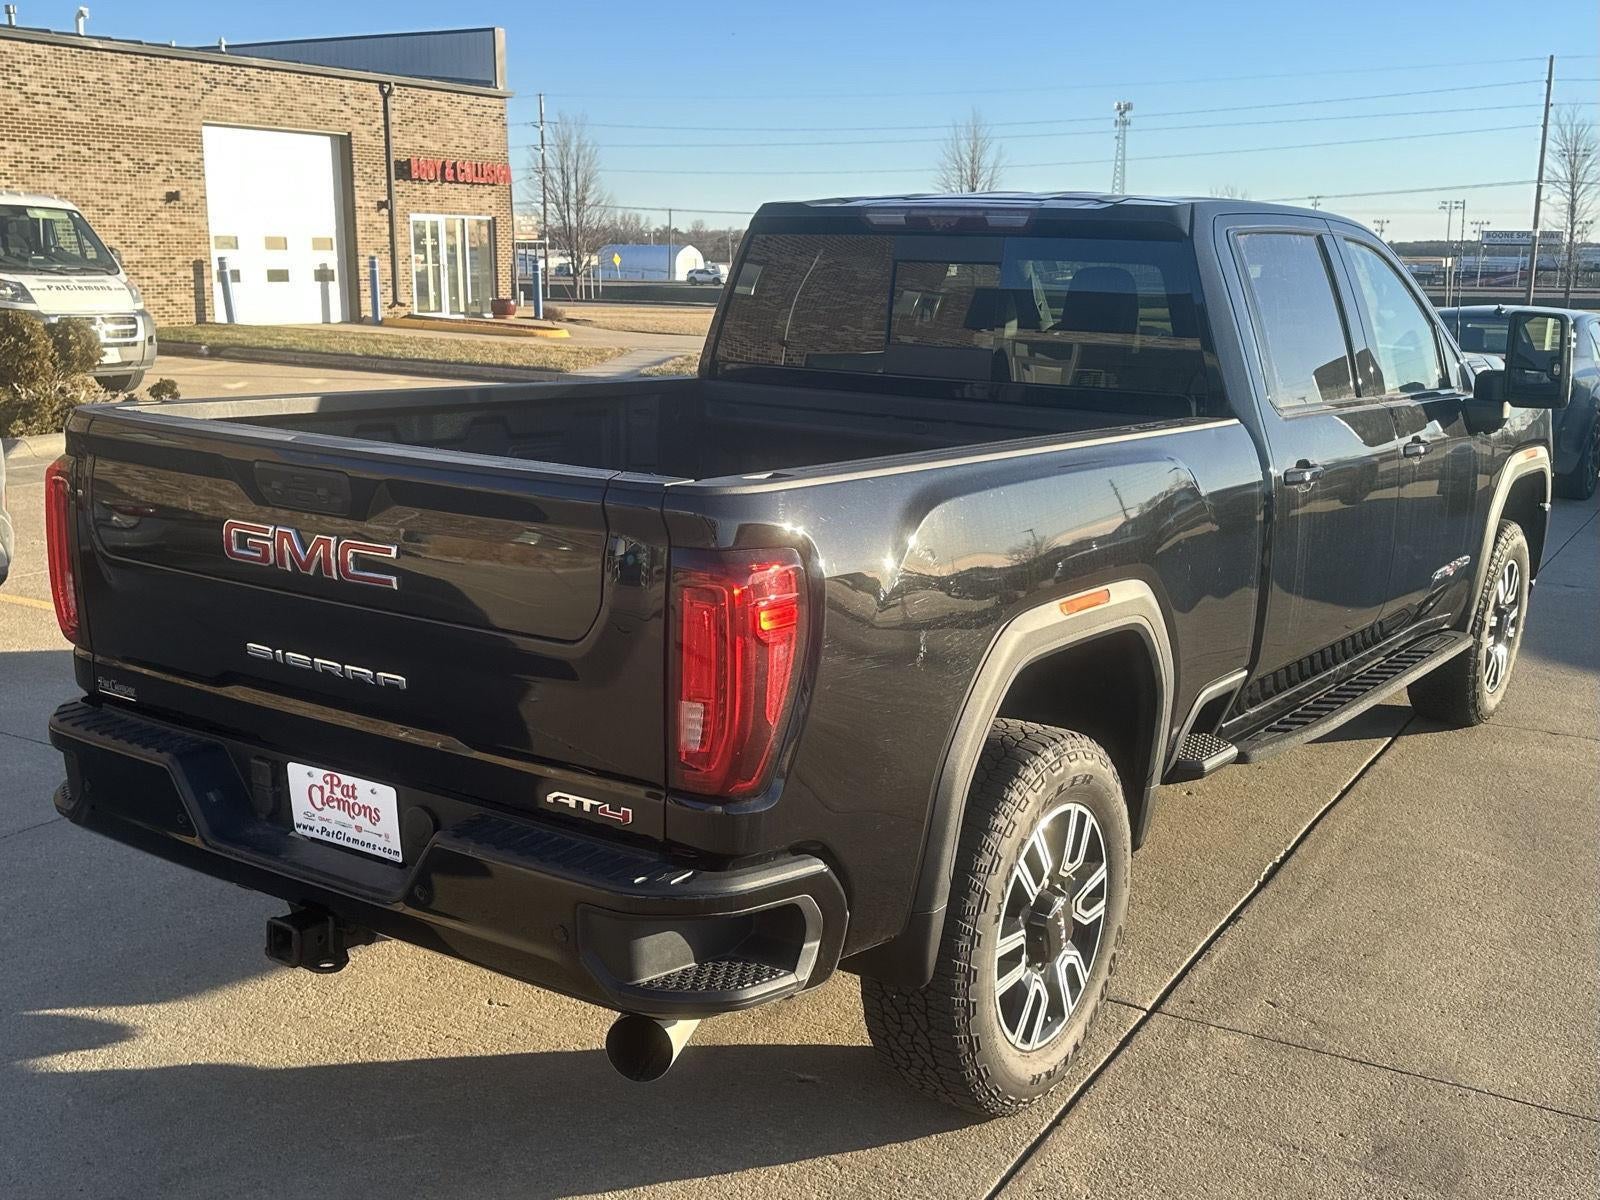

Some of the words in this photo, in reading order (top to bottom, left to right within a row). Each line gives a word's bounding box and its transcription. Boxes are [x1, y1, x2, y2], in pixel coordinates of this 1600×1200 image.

[410, 155, 442, 181] BODY
[445, 159, 455, 182] &
[456, 160, 511, 185] COLLISION
[1486, 231, 1515, 239] BOONE
[1517, 231, 1560, 239] SPEWAY
[223, 519, 398, 590] GMC
[246, 643, 407, 689] SIERRA
[323, 773, 358, 800] Pat
[308, 783, 381, 826] Clemons
[546, 791, 632, 825] AT4
